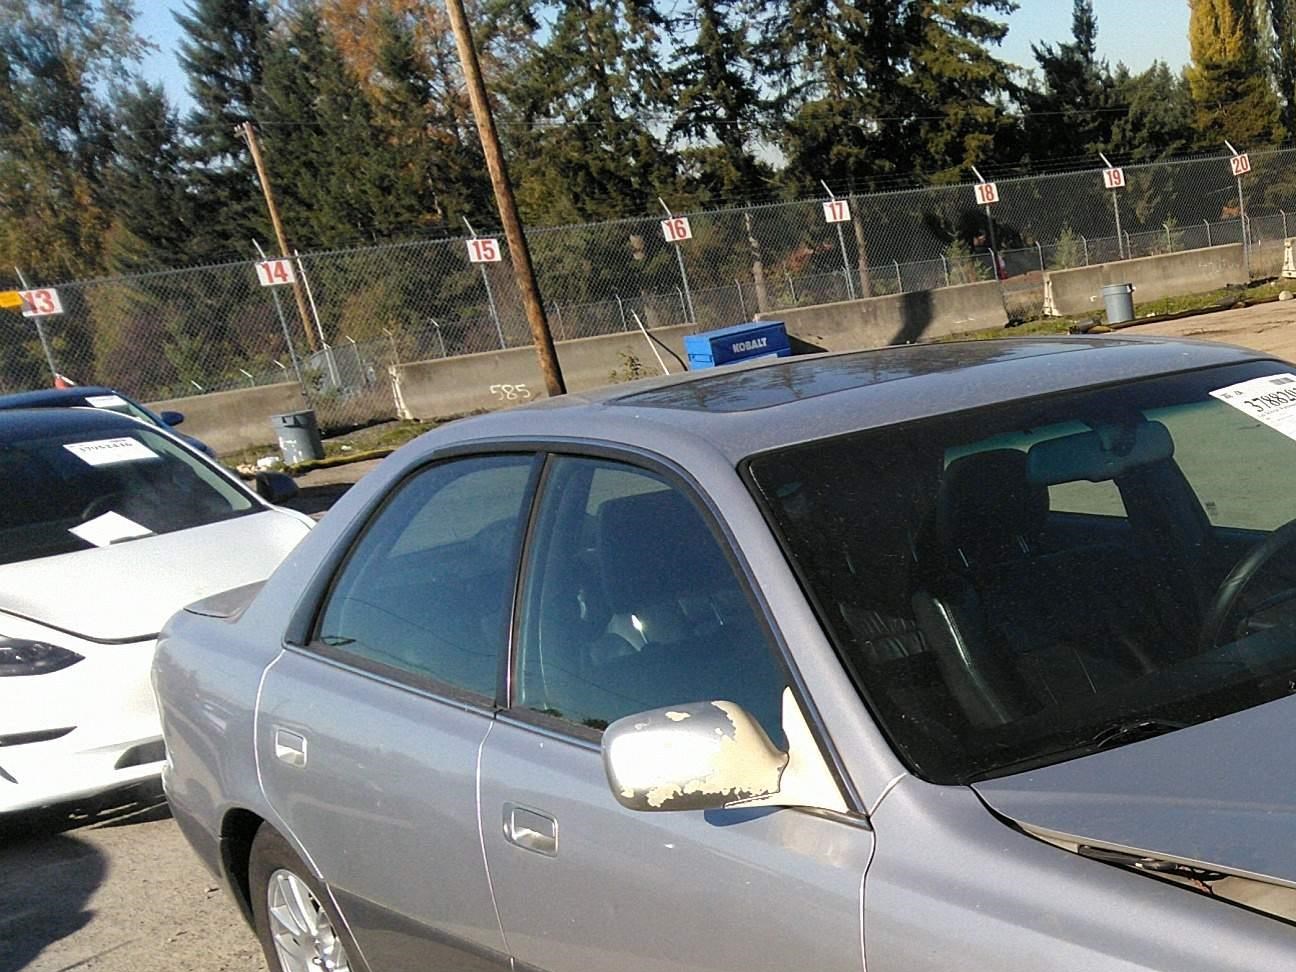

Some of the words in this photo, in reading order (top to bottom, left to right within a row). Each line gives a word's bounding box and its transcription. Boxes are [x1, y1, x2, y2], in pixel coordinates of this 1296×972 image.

[1233, 156, 1248, 173] 20
[1106, 169, 1122, 186] 19
[978, 183, 994, 201] 18
[827, 202, 844, 220] 17
[667, 219, 687, 240] 16
[471, 240, 495, 261] 15
[261, 261, 288, 284] 14
[22, 290, 55, 314] 13
[732, 336, 767, 353] KOBALT
[489, 384, 531, 400] 585
